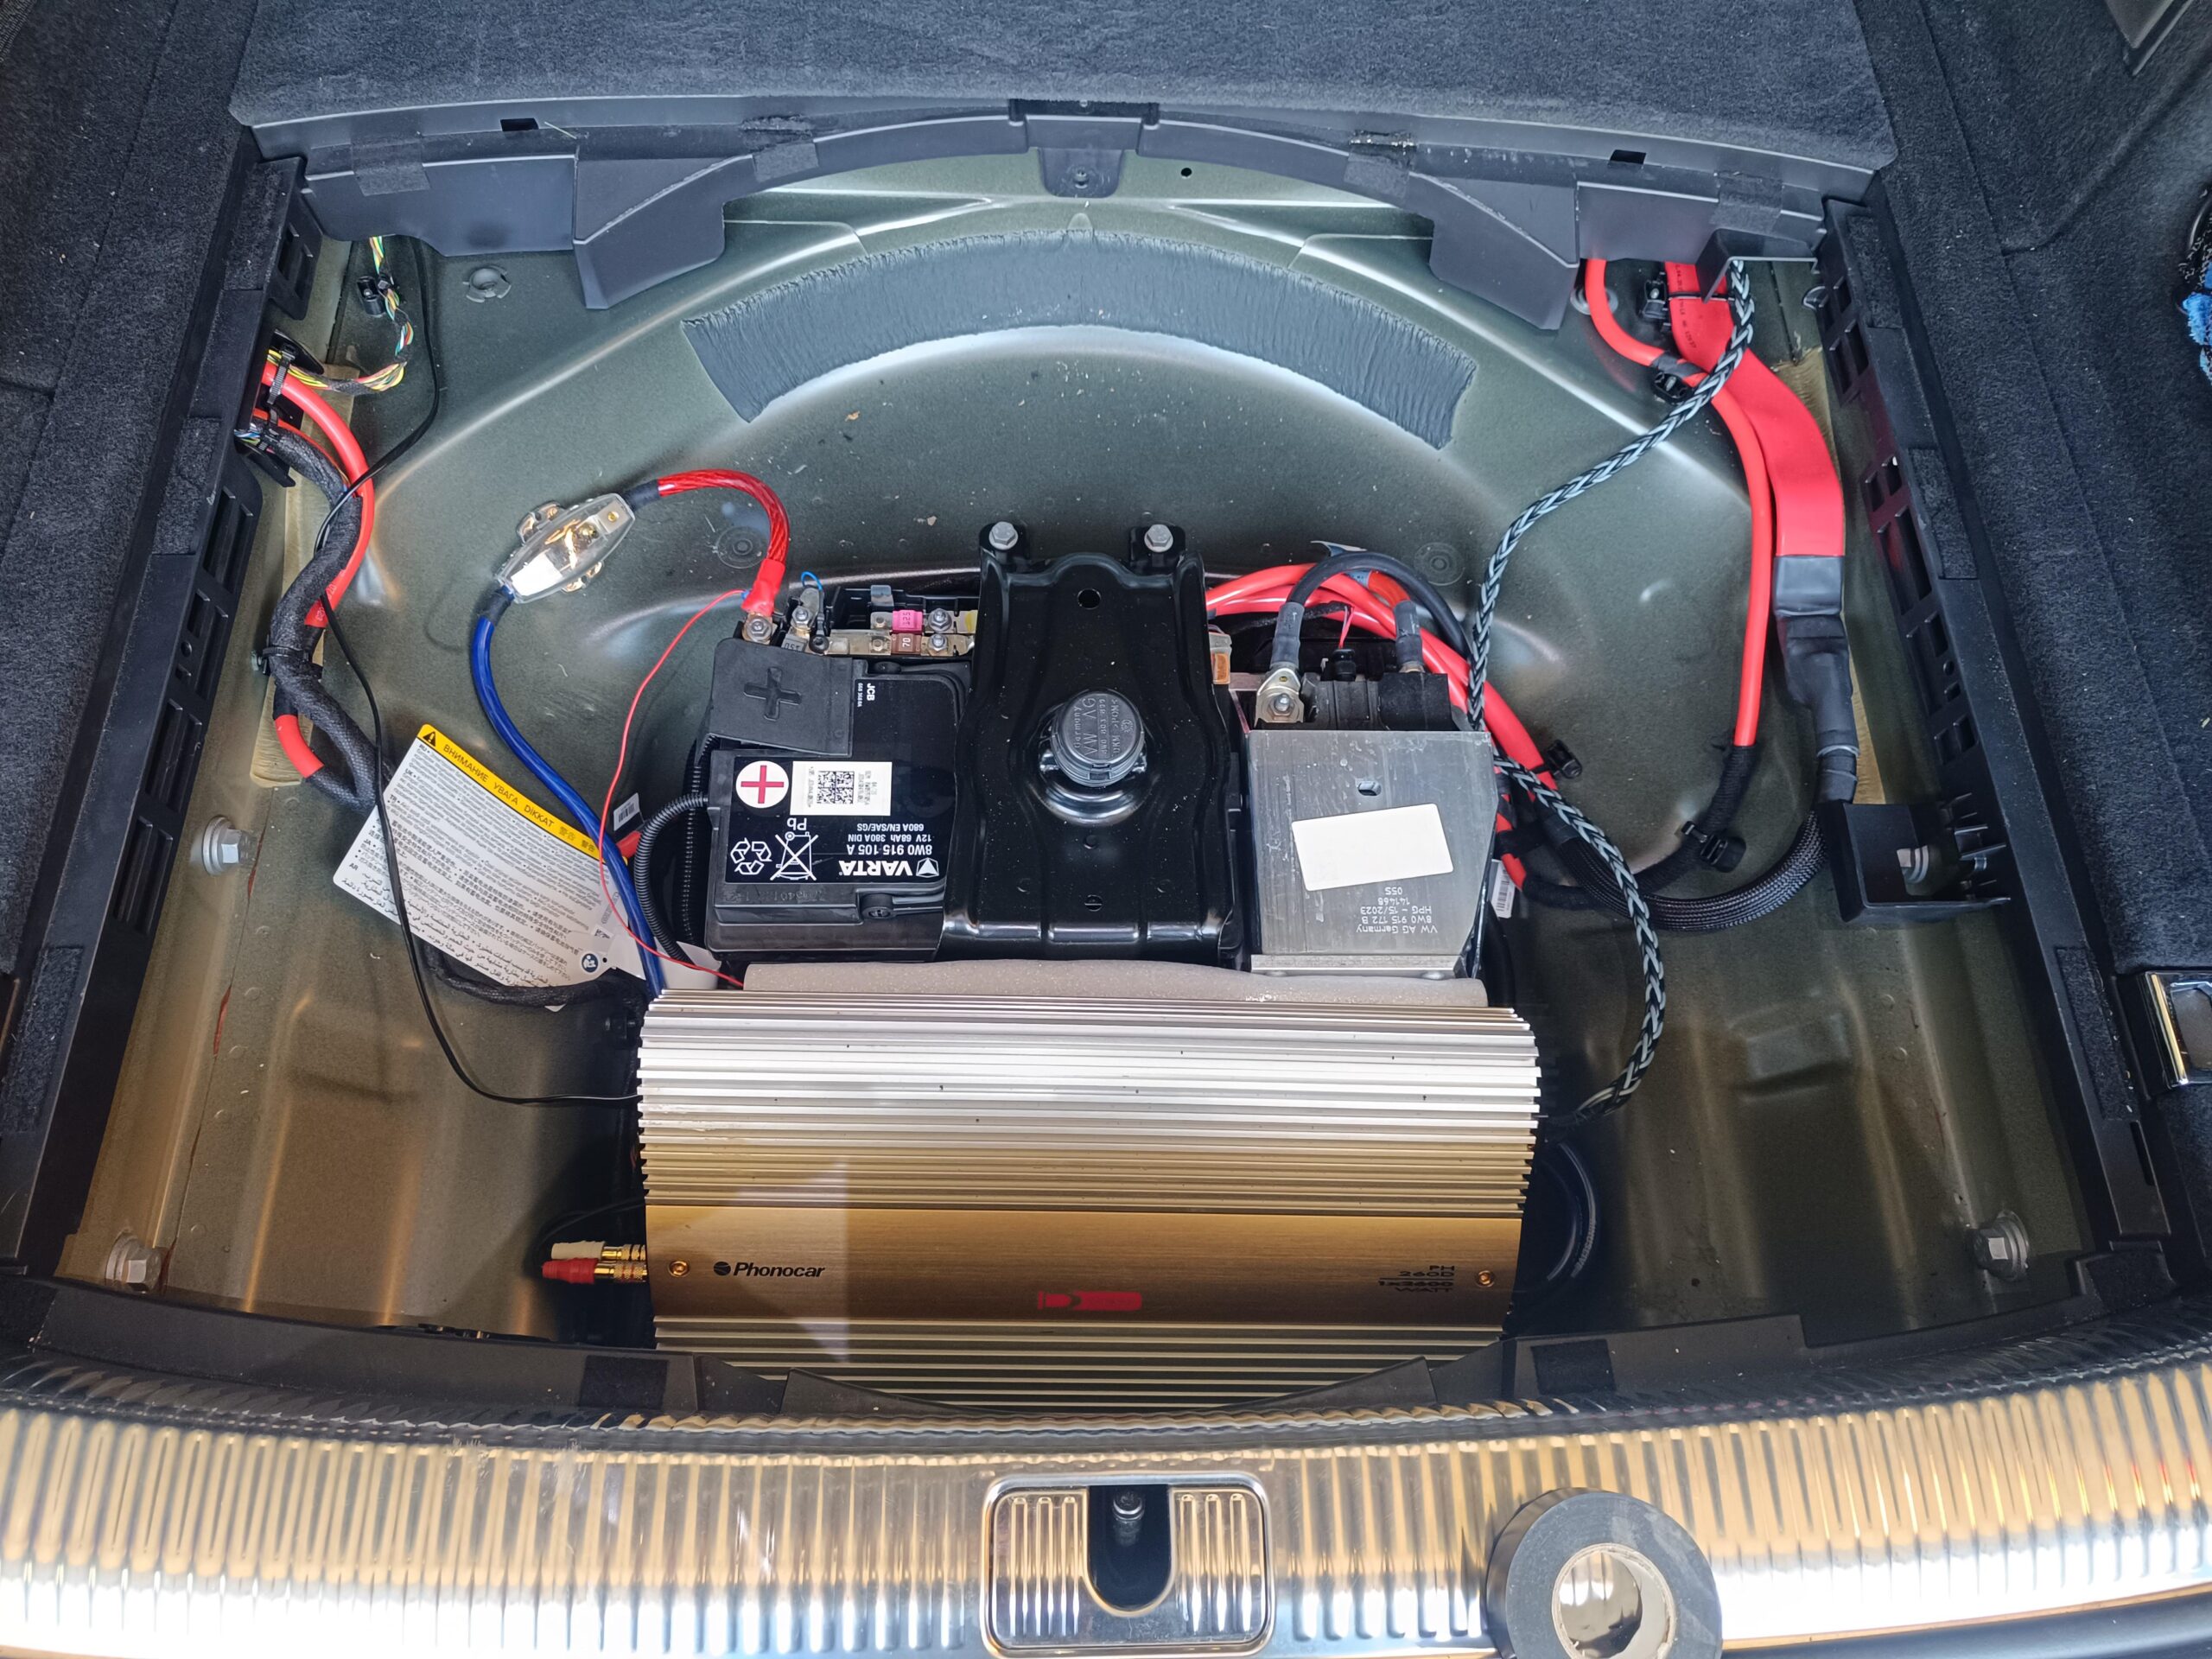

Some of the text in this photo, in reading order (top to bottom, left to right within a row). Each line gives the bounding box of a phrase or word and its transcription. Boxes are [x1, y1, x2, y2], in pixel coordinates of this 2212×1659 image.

[902, 638, 911, 647] 70
[867, 683, 875, 701] JCB
[1084, 733, 1097, 755] VW
[442, 744, 519, 805] ВНИМАНИЕ УВАГА
[787, 817, 807, 830] Pb
[847, 844, 932, 855] 8W0 915 105 A
[348, 862, 359, 871] AR
[839, 861, 912, 876] VARTA
[1411, 915, 1432, 924] 8W0
[1357, 924, 1398, 933] Germany
[733, 1262, 826, 1278] Phonocar
